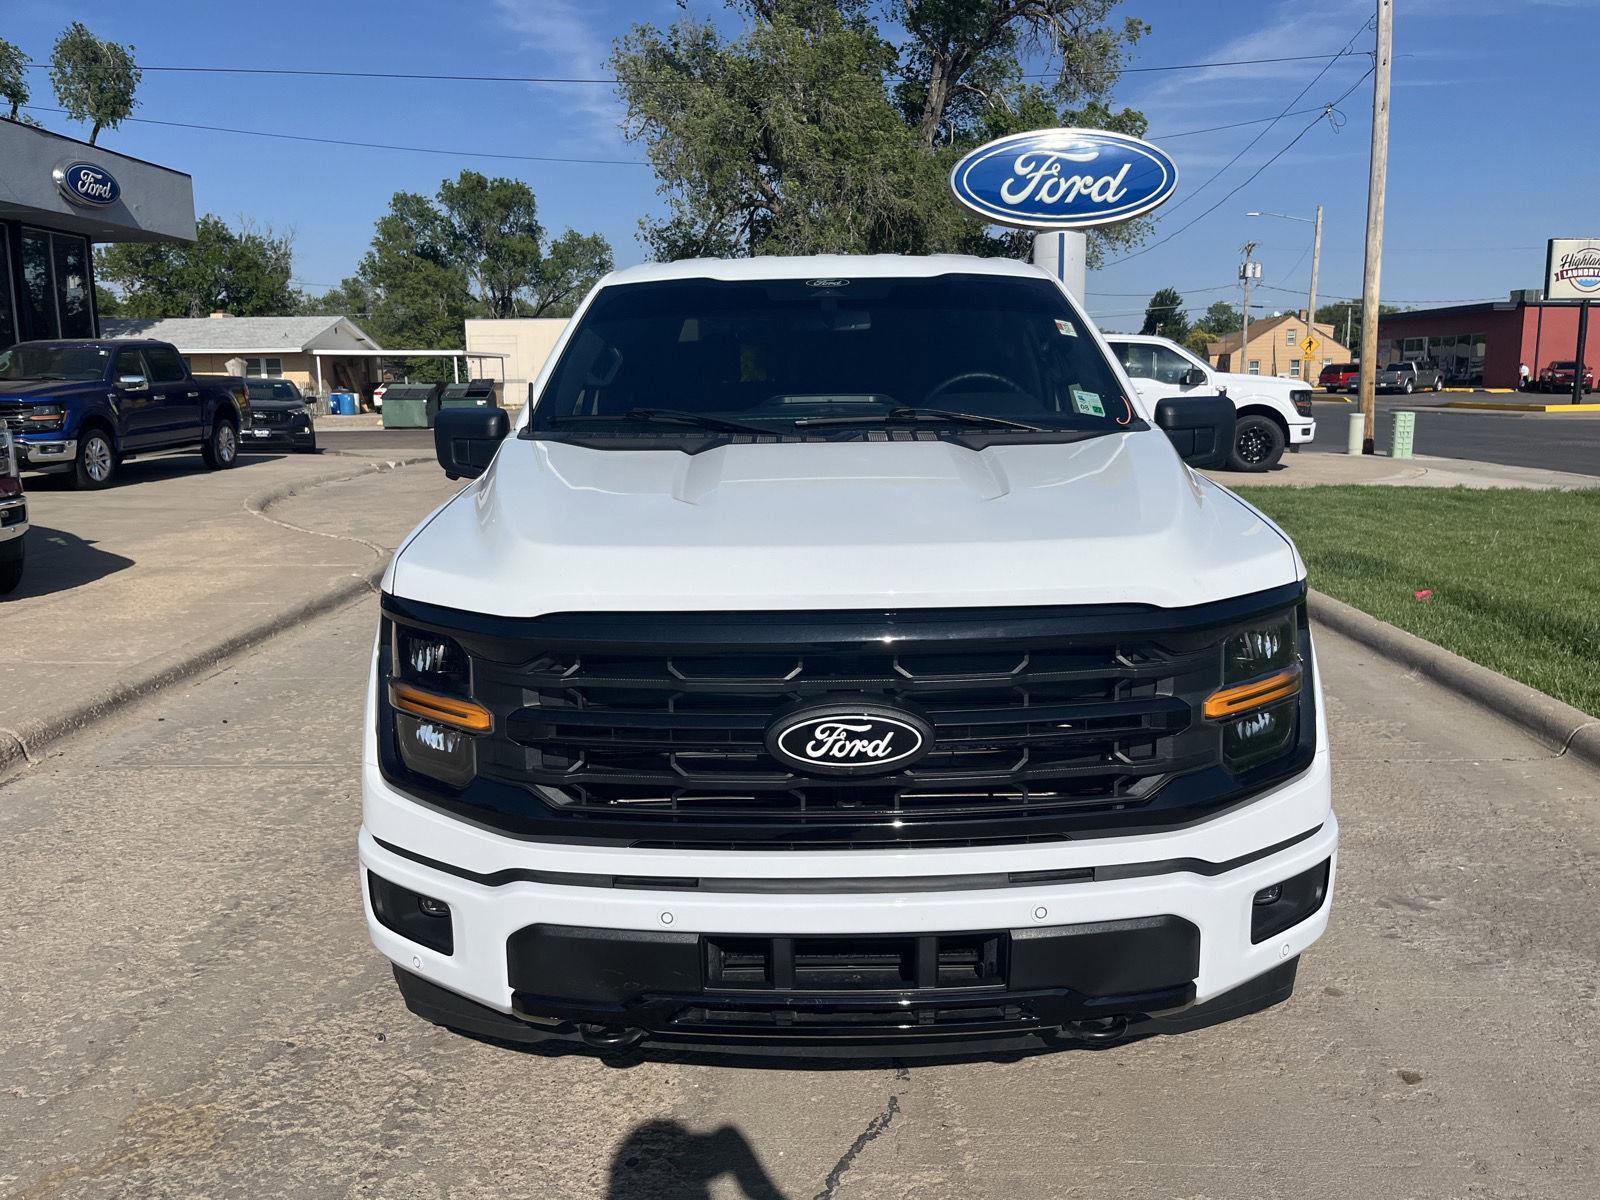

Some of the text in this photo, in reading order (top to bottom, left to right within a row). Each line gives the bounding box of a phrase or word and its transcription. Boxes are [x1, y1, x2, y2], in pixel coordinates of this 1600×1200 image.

[77, 169, 112, 199] Ford
[1000, 149, 1132, 205] Ford
[813, 279, 843, 287] Ford
[1563, 268, 1600, 278] LAUNDRY
[805, 722, 895, 758] Ford
